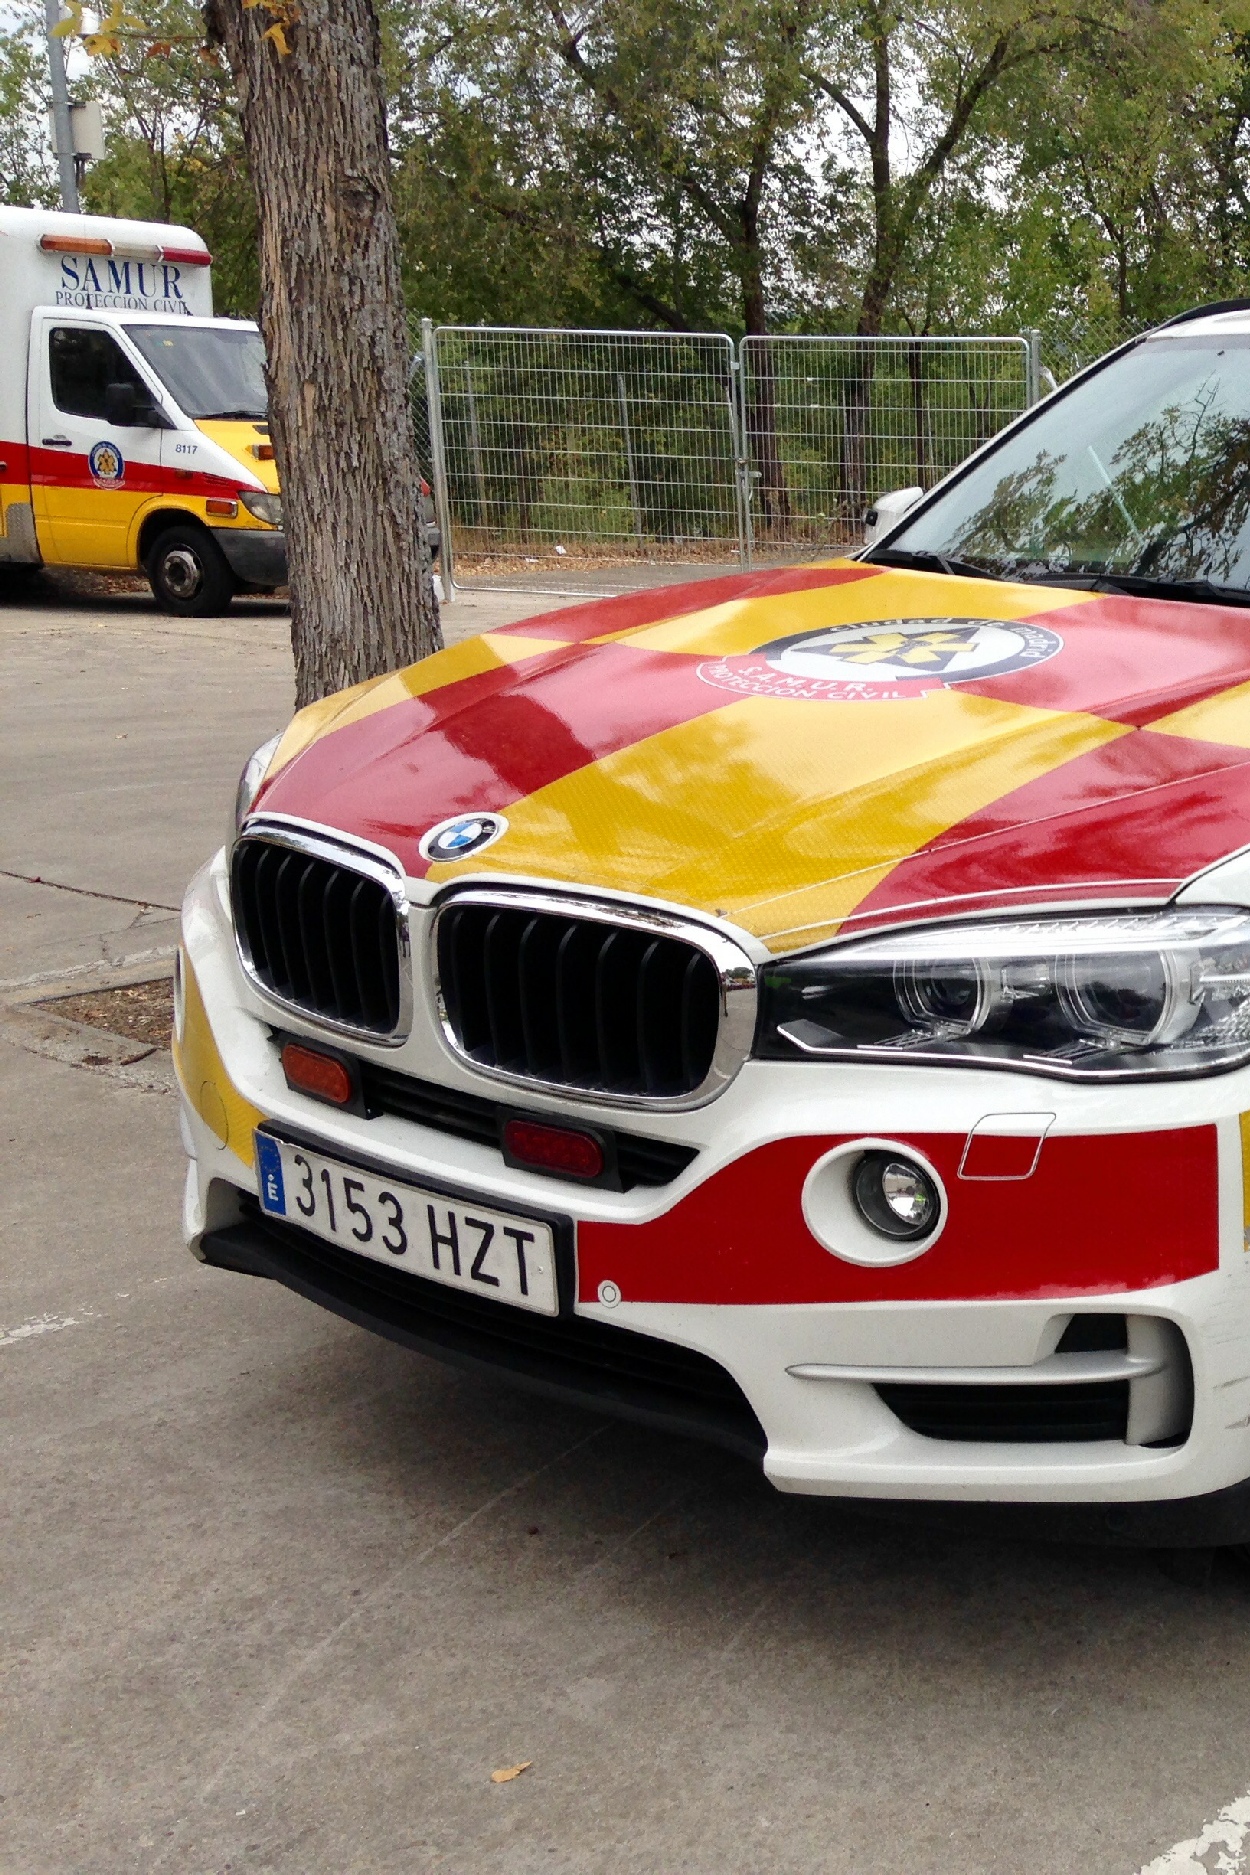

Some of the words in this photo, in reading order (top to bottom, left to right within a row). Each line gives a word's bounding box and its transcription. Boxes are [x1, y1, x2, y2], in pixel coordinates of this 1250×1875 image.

[61, 255, 184, 299] SAMUR
[175, 444, 198, 454] 8117
[829, 617, 952, 633] ciudad
[967, 620, 1005, 628] de
[1009, 626, 1056, 658] madrid
[708, 664, 815, 699] PROTECCION
[825, 691, 908, 700] CIVIL
[738, 665, 874, 692] S.A.M.U.R.
[268, 1181, 279, 1202] E
[294, 1154, 408, 1255] 3153
[427, 1204, 535, 1296] HZT
